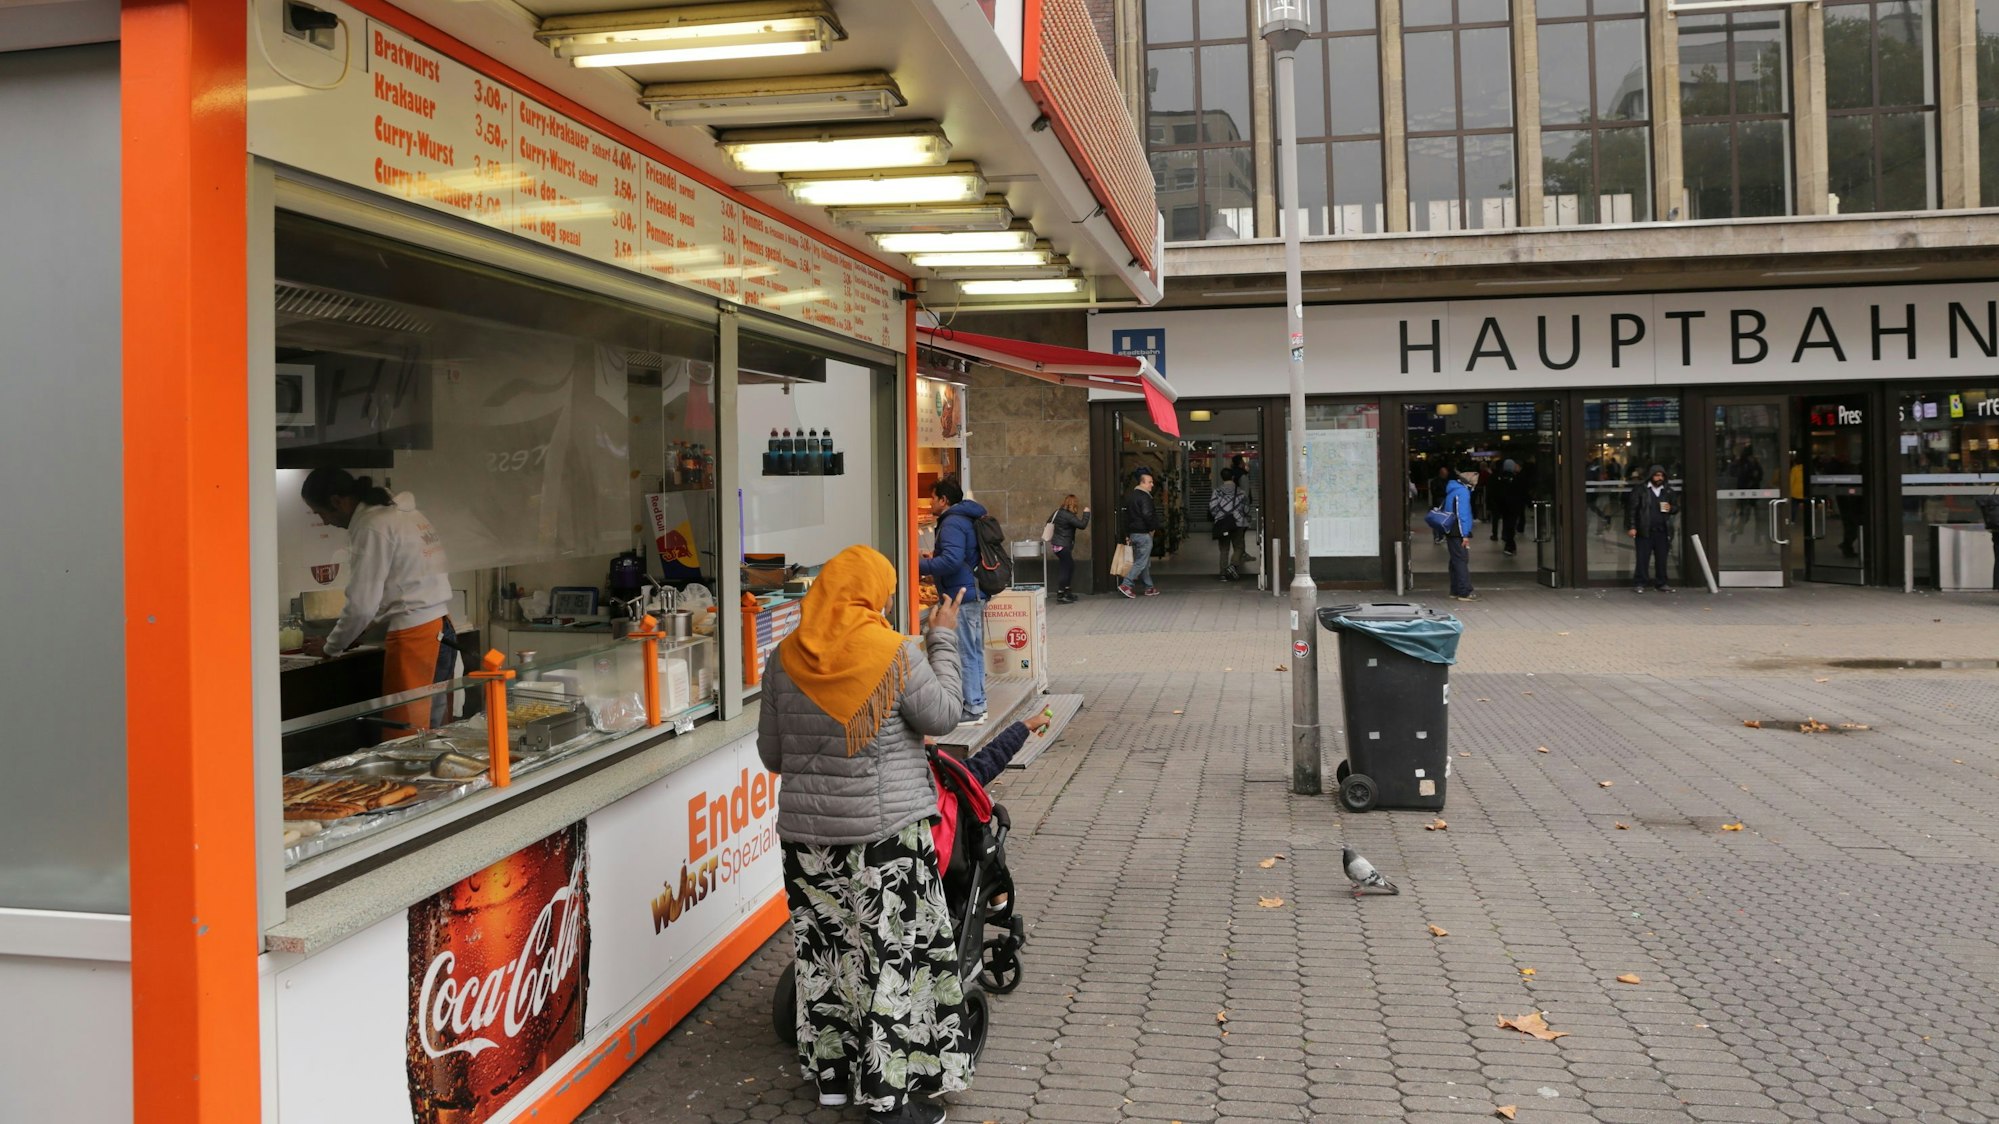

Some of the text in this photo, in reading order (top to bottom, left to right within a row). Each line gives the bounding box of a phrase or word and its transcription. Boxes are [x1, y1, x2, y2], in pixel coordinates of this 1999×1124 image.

[374, 29, 439, 84] Bratwurst
[374, 71, 435, 121] Krakauer
[375, 113, 453, 167] Curry-Wurst
[520, 100, 588, 153] Curry-Krakauer
[592, 140, 610, 162] scharf
[520, 135, 575, 179] Curry-Wurst
[578, 166, 597, 188] scharf
[646, 160, 676, 192] Fricandel
[540, 179, 556, 206] dog
[646, 190, 676, 220] Fricandel
[540, 215, 555, 242] dog
[559, 226, 580, 247] spezial
[646, 220, 673, 248] Pommes
[1399, 300, 1998, 373] HAUPTBAHN
[651, 495, 665, 532] Red Bull
[418, 850, 582, 1059] Coca-Cola
